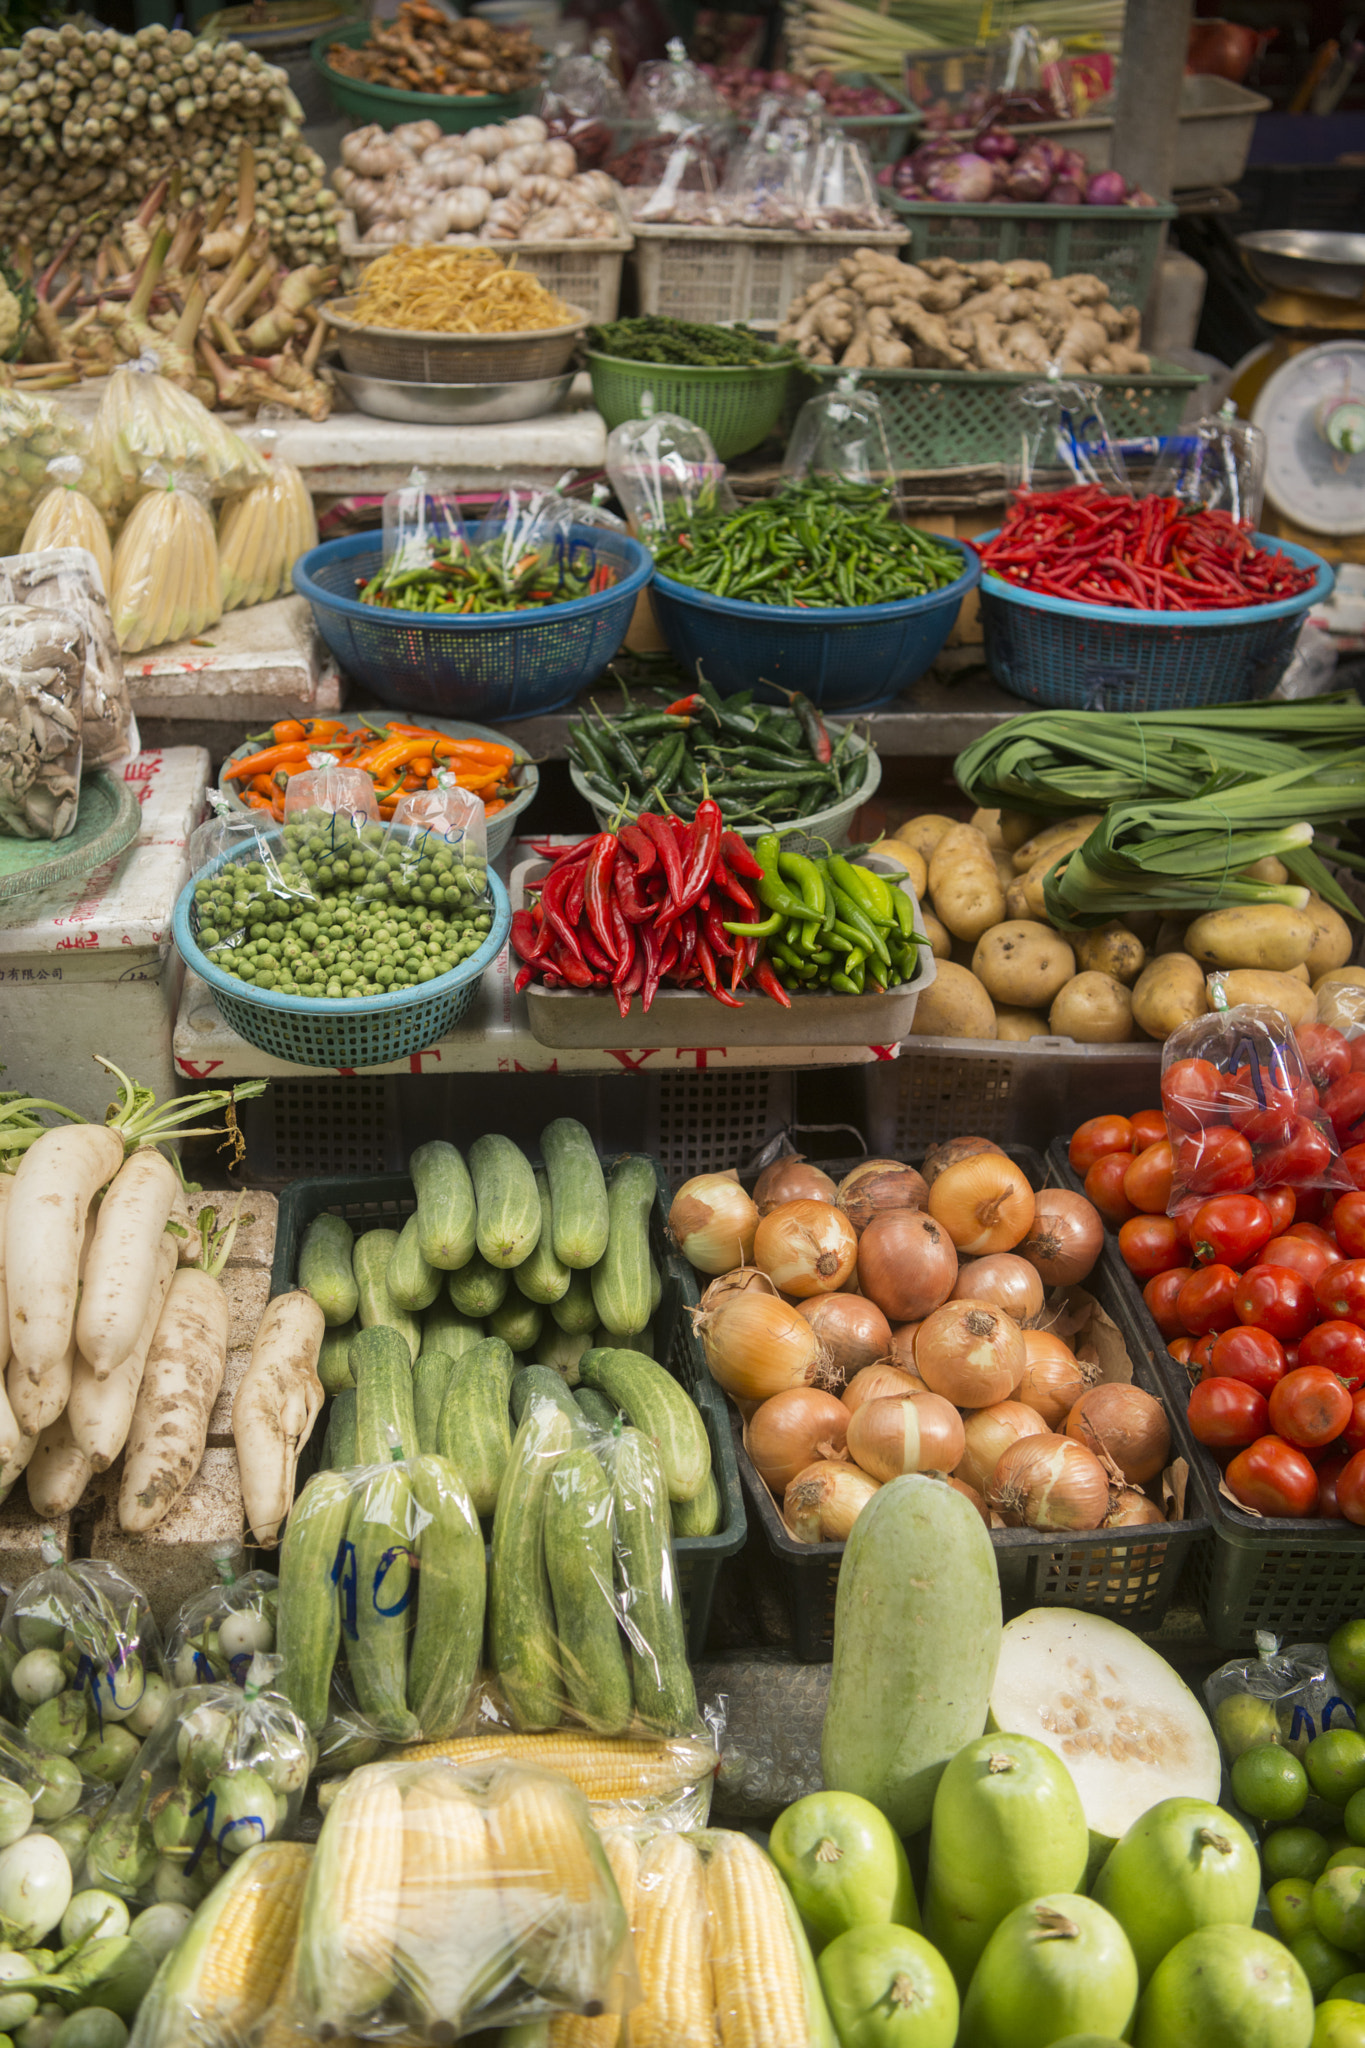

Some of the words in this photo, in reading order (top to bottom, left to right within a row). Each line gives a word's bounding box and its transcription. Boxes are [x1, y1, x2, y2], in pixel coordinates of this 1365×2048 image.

[556, 533, 597, 592] 10
[319, 810, 367, 860] 10
[410, 823, 464, 865] 10
[1228, 1036, 1302, 1112] 10
[330, 1538, 420, 1642] 10
[72, 1645, 147, 1743] 10
